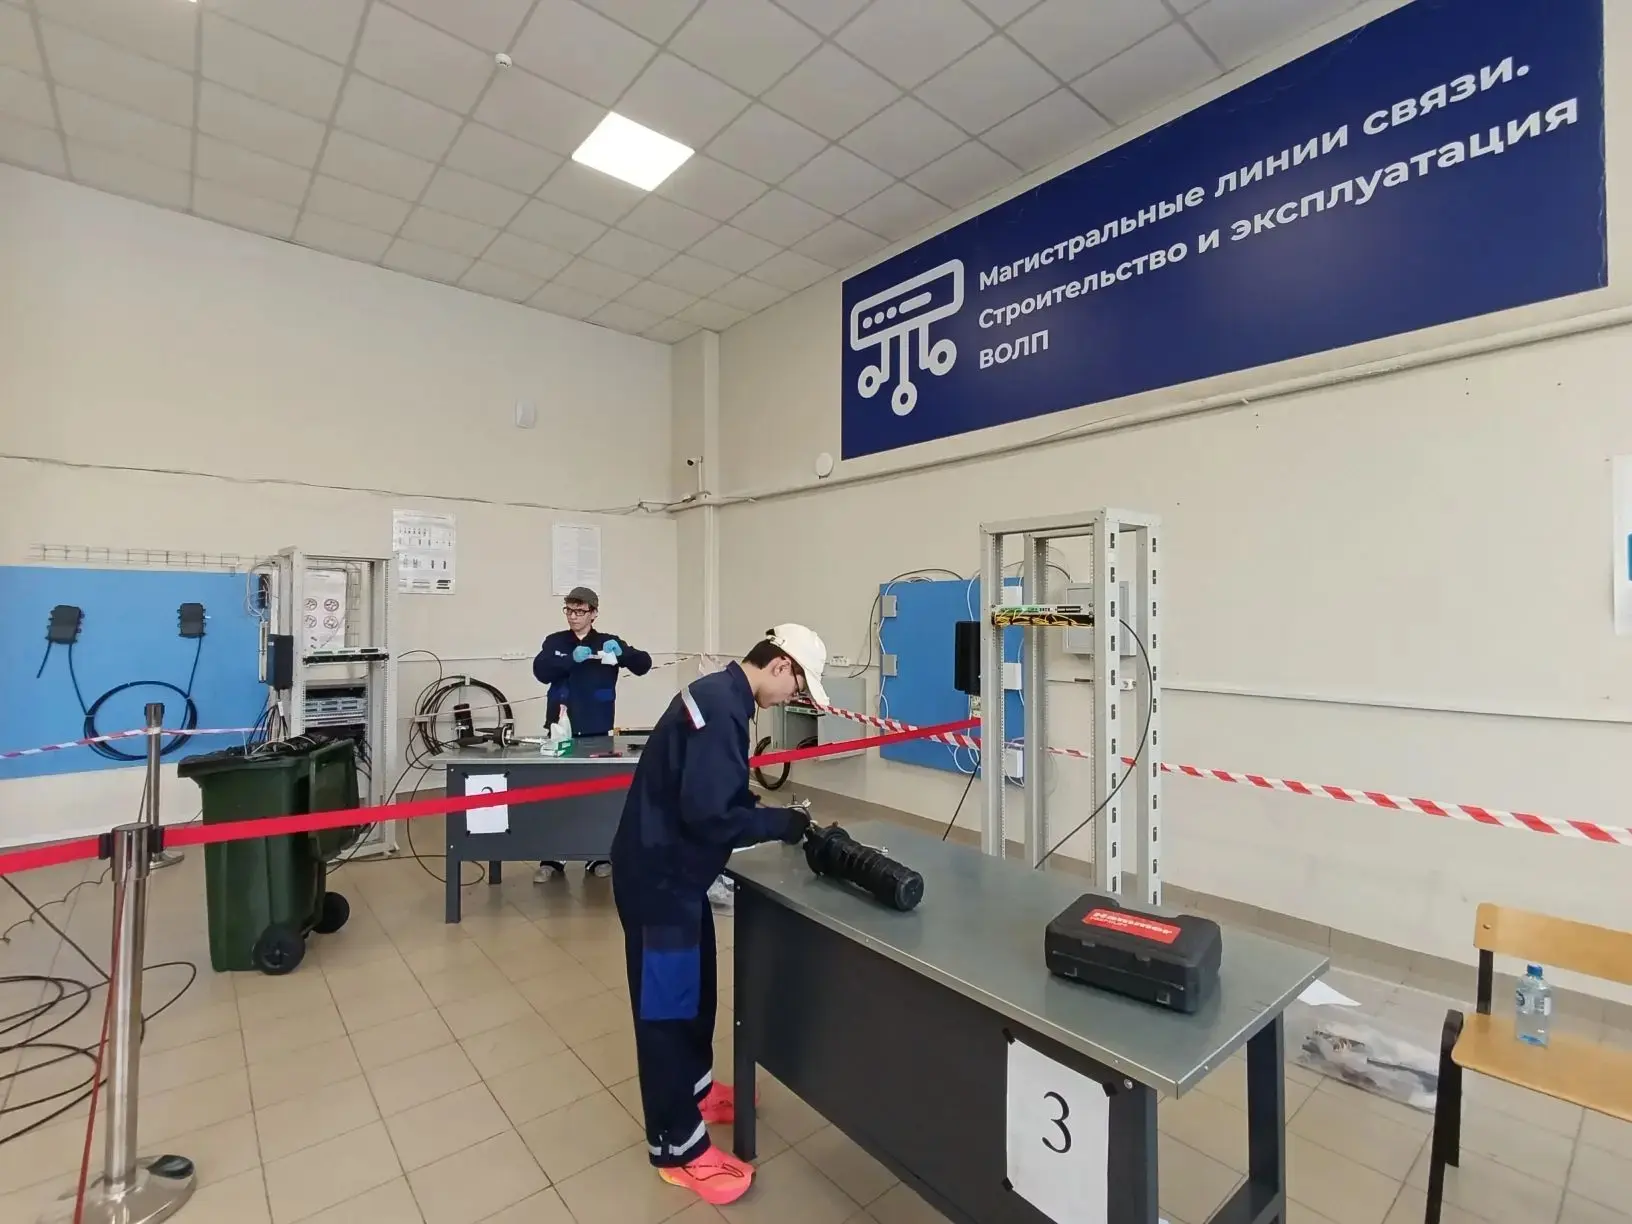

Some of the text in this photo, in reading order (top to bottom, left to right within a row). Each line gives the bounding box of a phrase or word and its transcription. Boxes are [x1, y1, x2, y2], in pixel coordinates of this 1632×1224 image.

[978, 97, 1578, 329] Строительство и эксплуатация
[979, 56, 1530, 291] Магистральные линии связи.
[978, 329, 1049, 370] ВОЛП
[1042, 1091, 1072, 1154] 3
